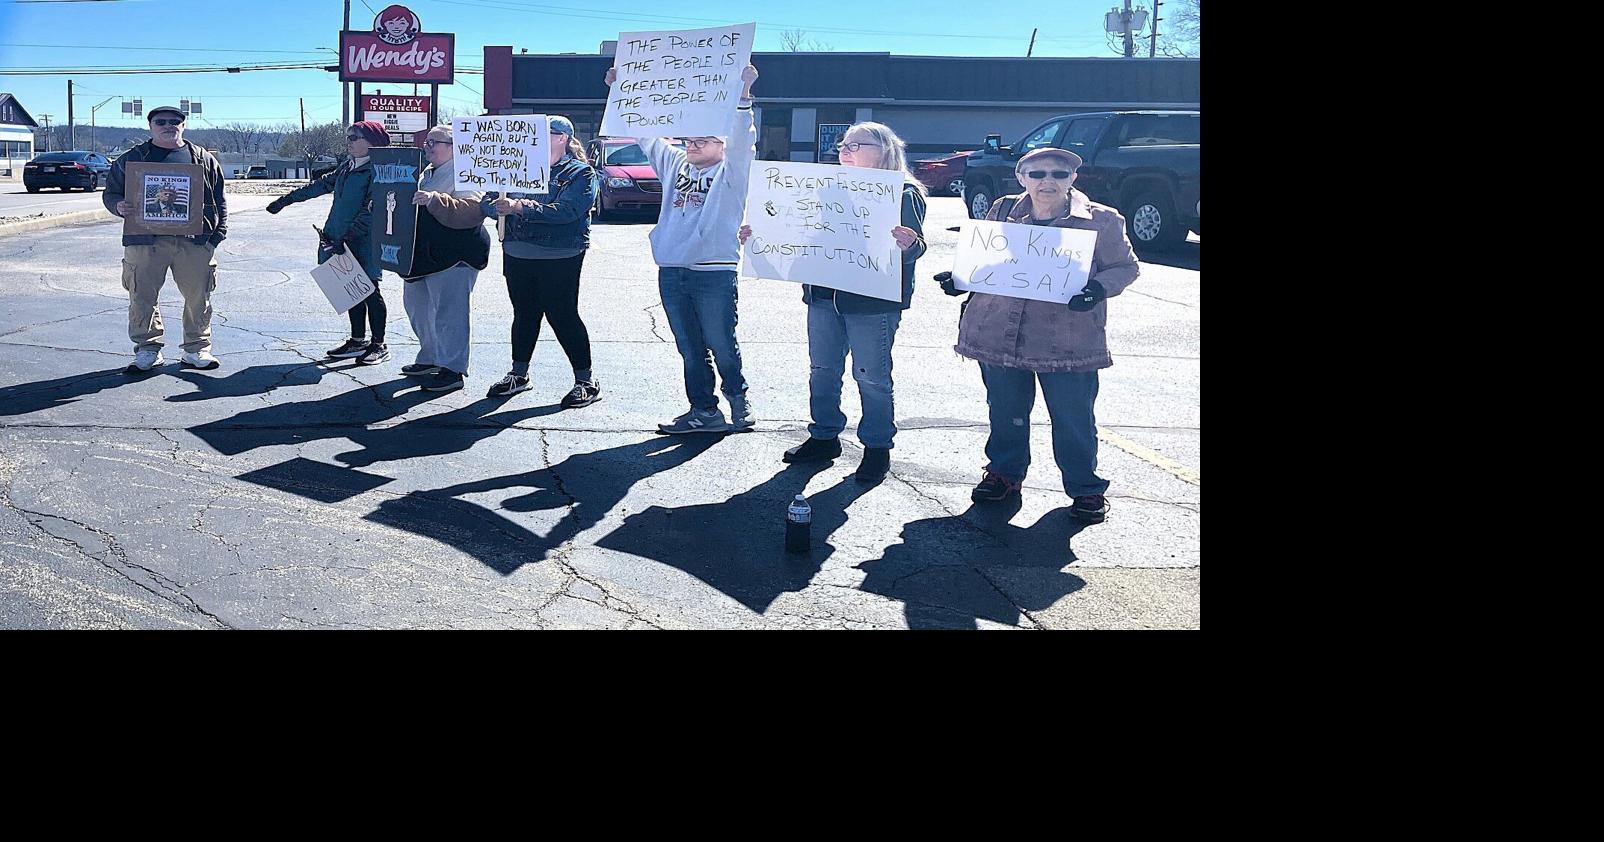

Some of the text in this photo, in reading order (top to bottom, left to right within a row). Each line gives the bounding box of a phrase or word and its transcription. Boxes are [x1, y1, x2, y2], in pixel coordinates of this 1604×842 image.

[628, 33, 740, 56] THE POWER OF
[349, 41, 445, 74] Wendy's
[622, 53, 737, 74] THE PEOPLE IS
[620, 73, 728, 94] GREATER THAN
[370, 98, 422, 107] QUALITY
[613, 90, 728, 111] THE PEOPLE IN
[460, 120, 536, 135] I WAS BORN
[473, 133, 539, 146] AGAIN, BUT I
[458, 144, 523, 158] WAS NOT BORN
[459, 169, 487, 187] Stop
[486, 171, 507, 185] The
[765, 167, 895, 203] PREVENT FASCISM
[796, 198, 844, 214] STAND
[852, 206, 870, 218] UP
[804, 216, 871, 238] FOR THE
[329, 253, 371, 301] NO KINGS
